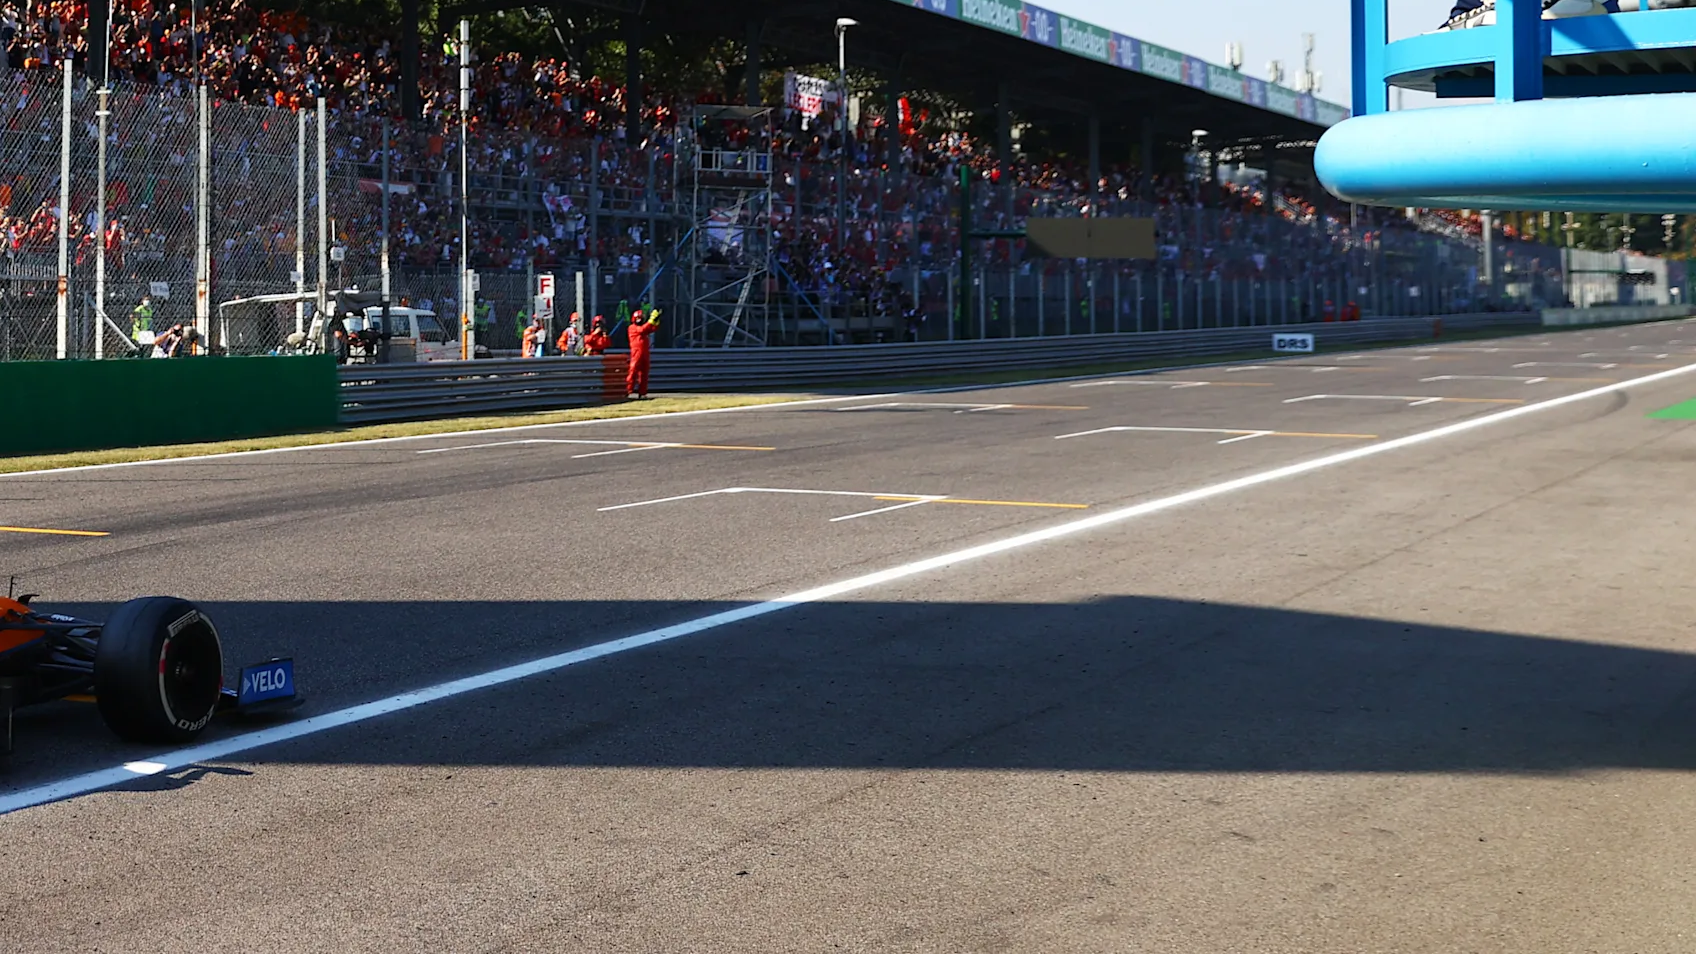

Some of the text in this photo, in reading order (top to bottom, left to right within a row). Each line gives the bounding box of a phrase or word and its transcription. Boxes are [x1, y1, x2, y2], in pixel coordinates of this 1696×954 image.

[540, 278, 551, 294] F
[1277, 338, 1309, 349] DRS
[252, 667, 286, 693] VELO
